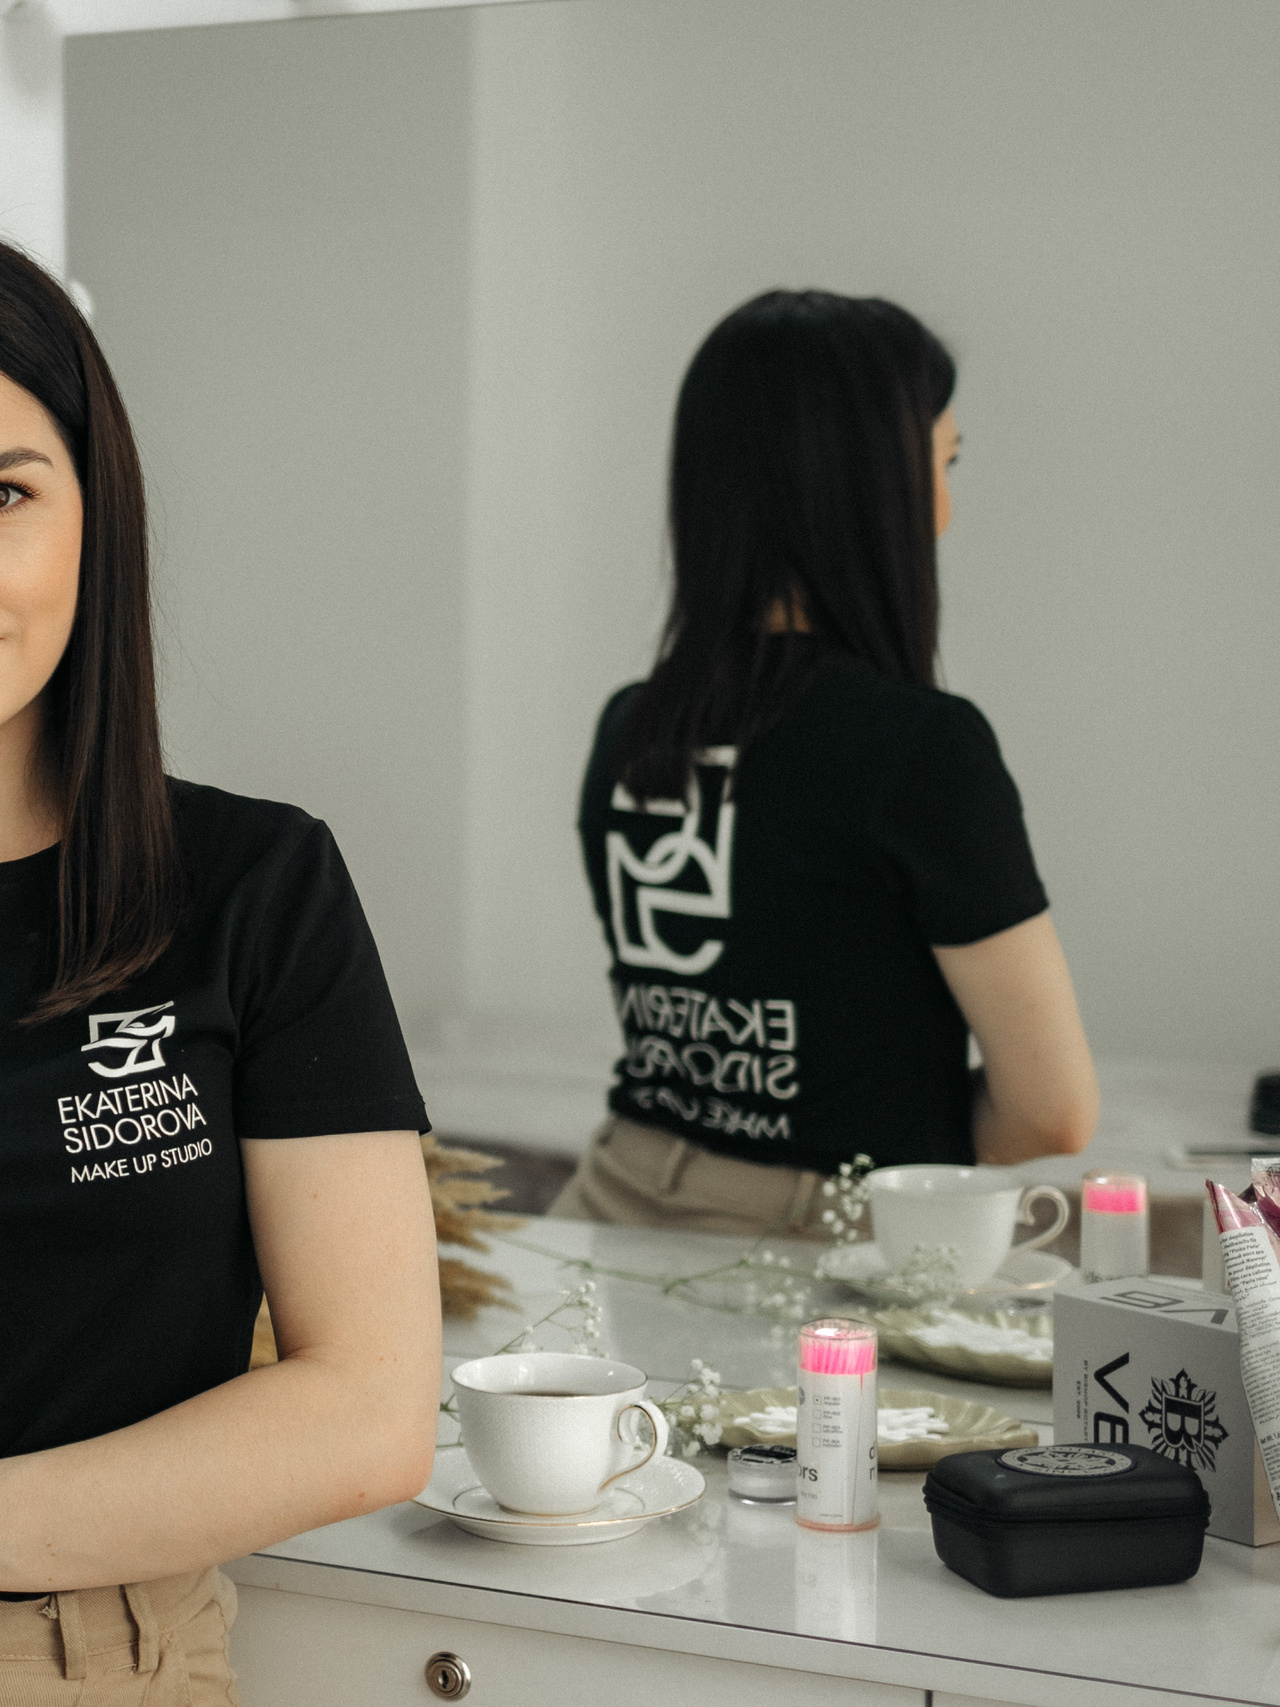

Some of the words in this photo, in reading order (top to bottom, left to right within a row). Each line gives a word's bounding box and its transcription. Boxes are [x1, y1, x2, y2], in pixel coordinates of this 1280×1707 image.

[58, 1072, 199, 1124] EKATERINA
[63, 1102, 207, 1154] SIDOROVA
[71, 1158, 130, 1183] MAKE
[132, 1153, 157, 1174] UP
[161, 1138, 213, 1168] STUDIO
